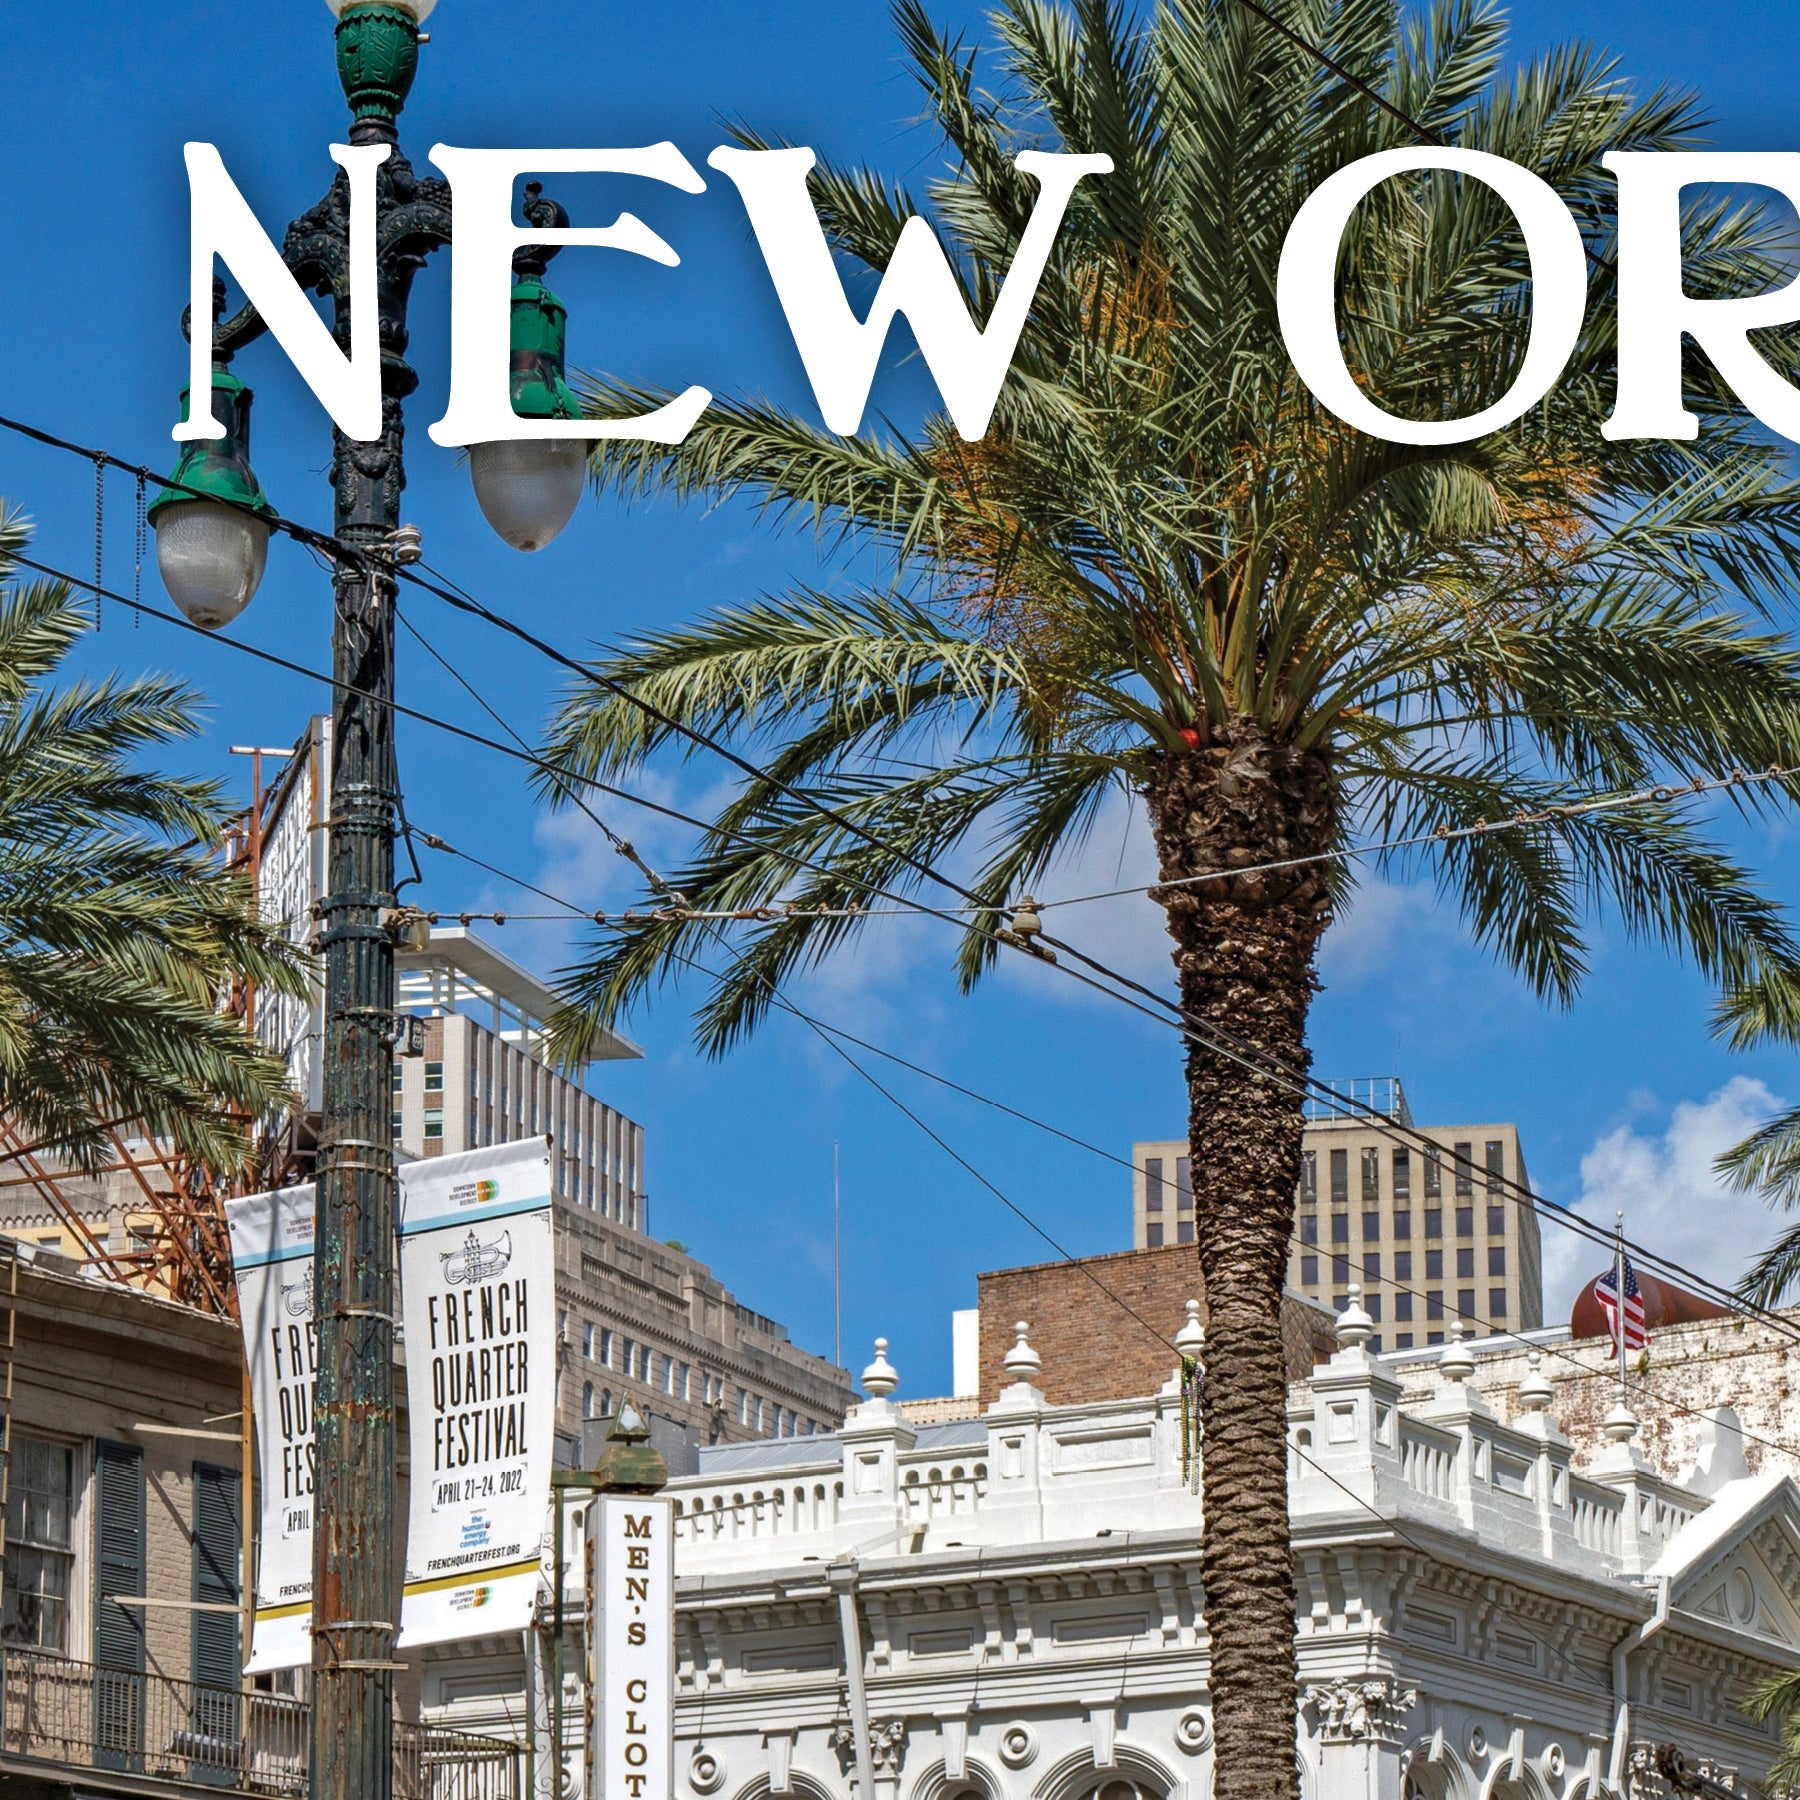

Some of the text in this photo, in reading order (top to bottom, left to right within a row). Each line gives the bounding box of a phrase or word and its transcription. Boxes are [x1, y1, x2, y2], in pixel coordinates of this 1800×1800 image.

[428, 1279, 527, 1349] FRENCH
[433, 1341, 528, 1414] QUARTER
[434, 1402, 528, 1471] FESTIVAL
[437, 1481, 461, 1505] APRIL
[500, 1469, 522, 1493] 2022
[287, 1509, 310, 1532] APRIL
[462, 1524, 484, 1533] human
[464, 1530, 487, 1541] energy
[427, 1544, 520, 1571] FRENCHQUARTERFEST.ORG
[459, 1537, 490, 1549] company
[624, 1514, 652, 1647] MEN'S
